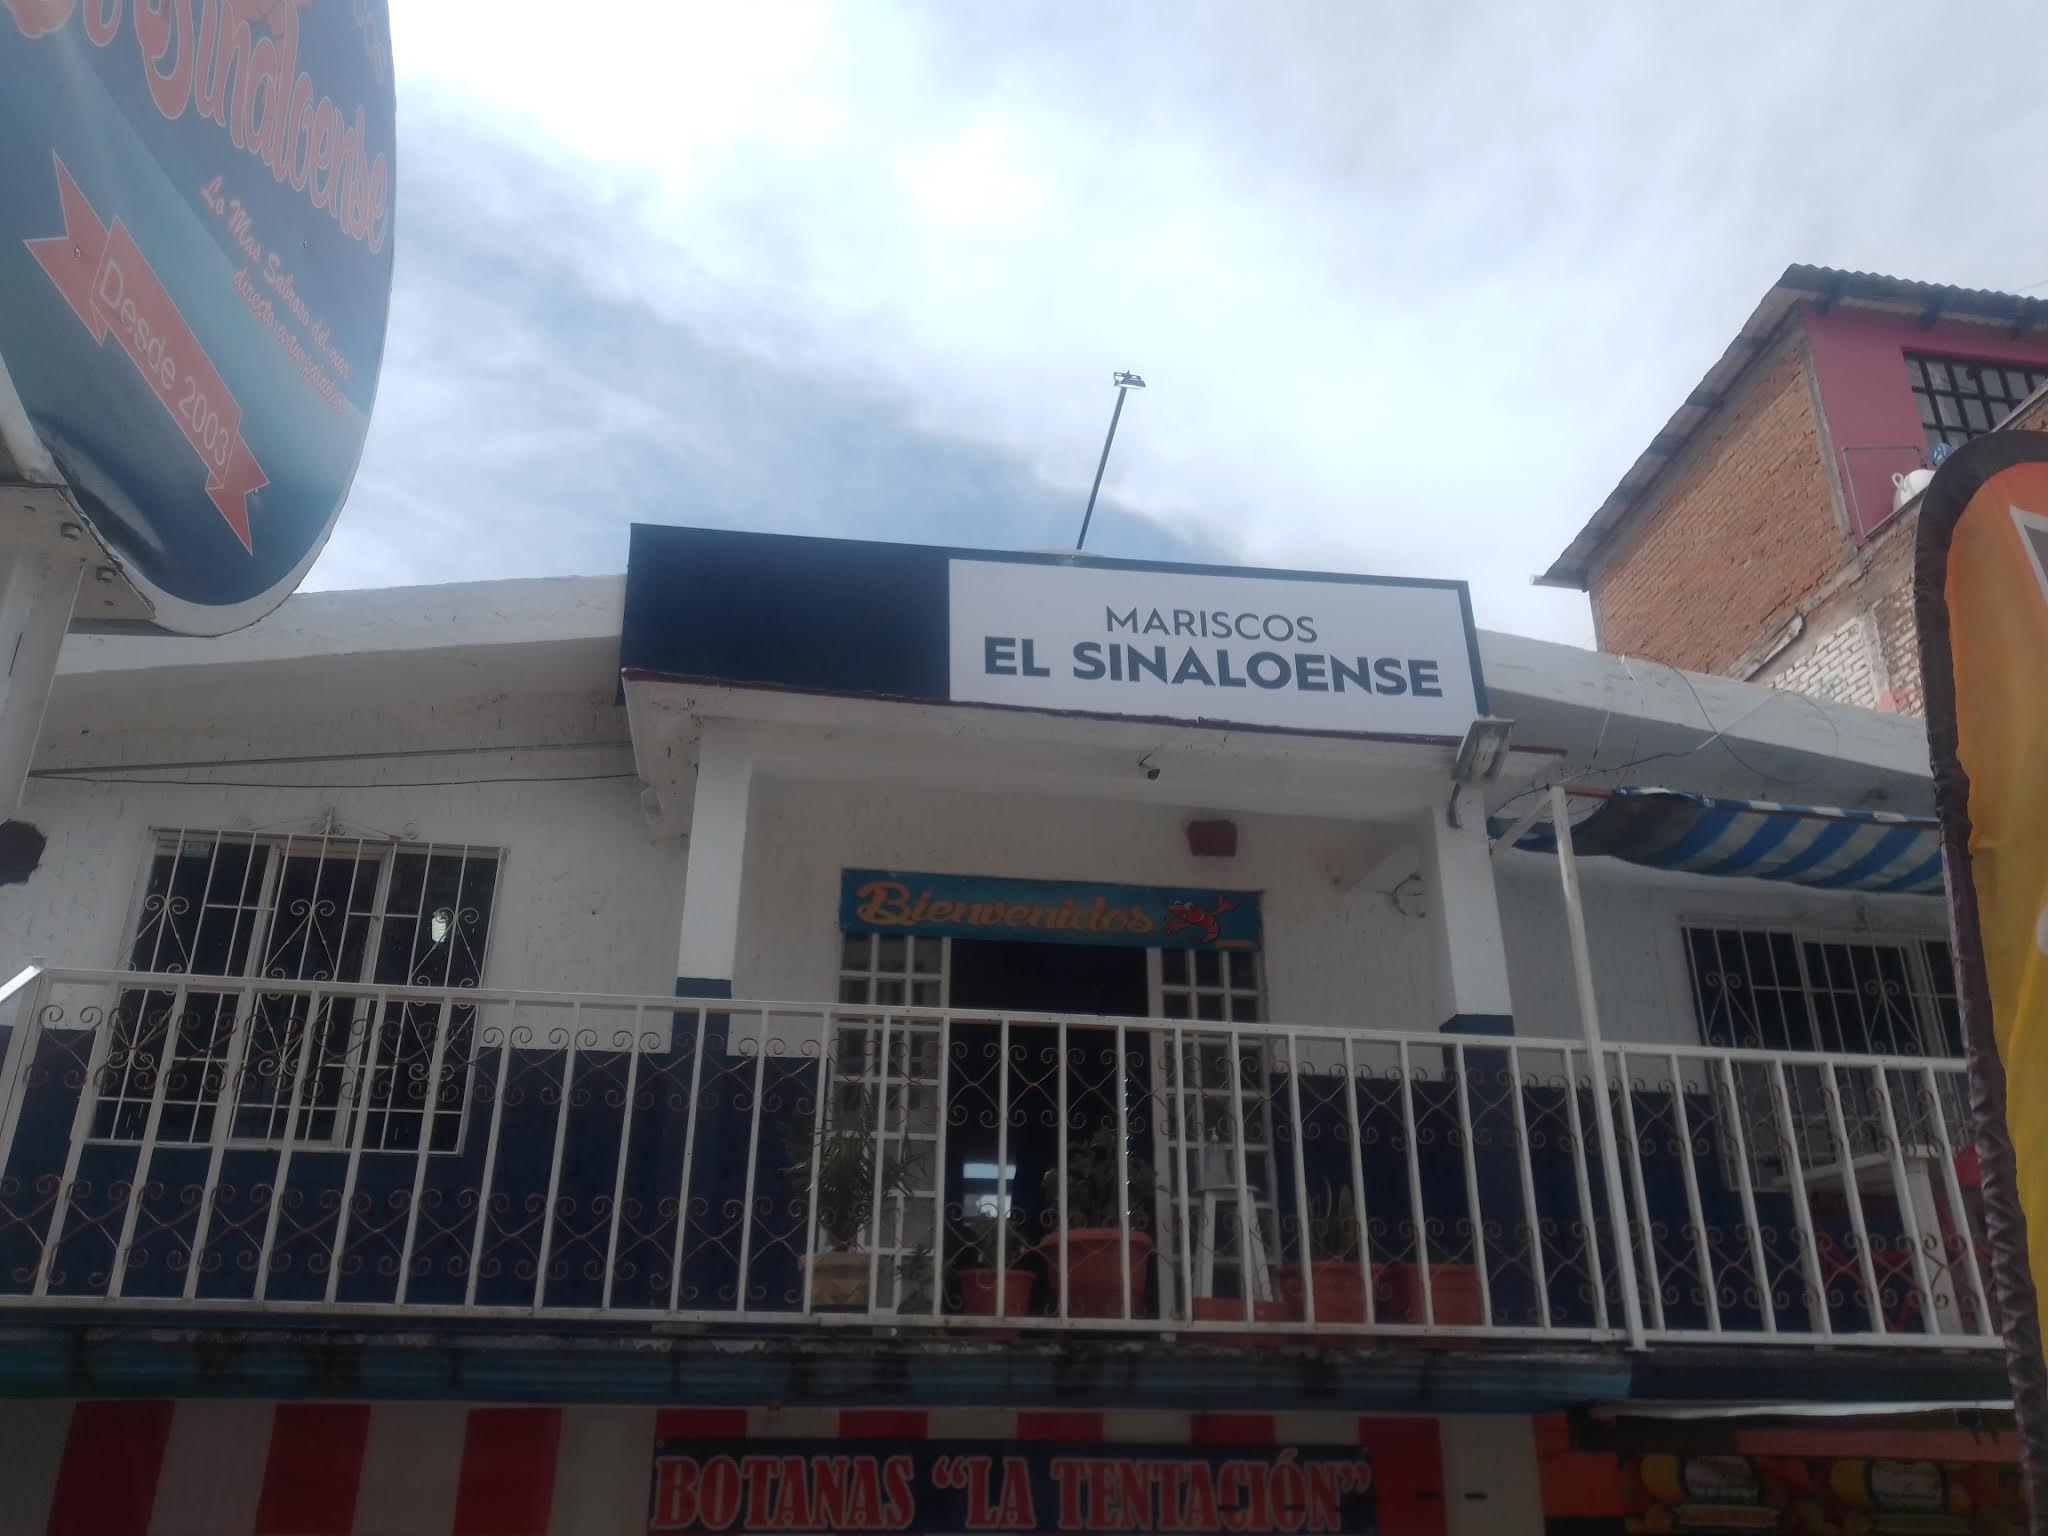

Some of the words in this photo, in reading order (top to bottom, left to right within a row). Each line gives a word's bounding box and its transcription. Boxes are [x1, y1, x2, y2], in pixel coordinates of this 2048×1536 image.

[100, 258, 177, 390] Desde
[177, 376, 230, 466] 2003
[1106, 605, 1318, 643] MARISCOS
[984, 635, 1051, 678] EL
[1072, 641, 1443, 698] SINALOENSE
[857, 880, 1155, 934] Bienvenidos
[649, 1455, 915, 1531] BOTANAS
